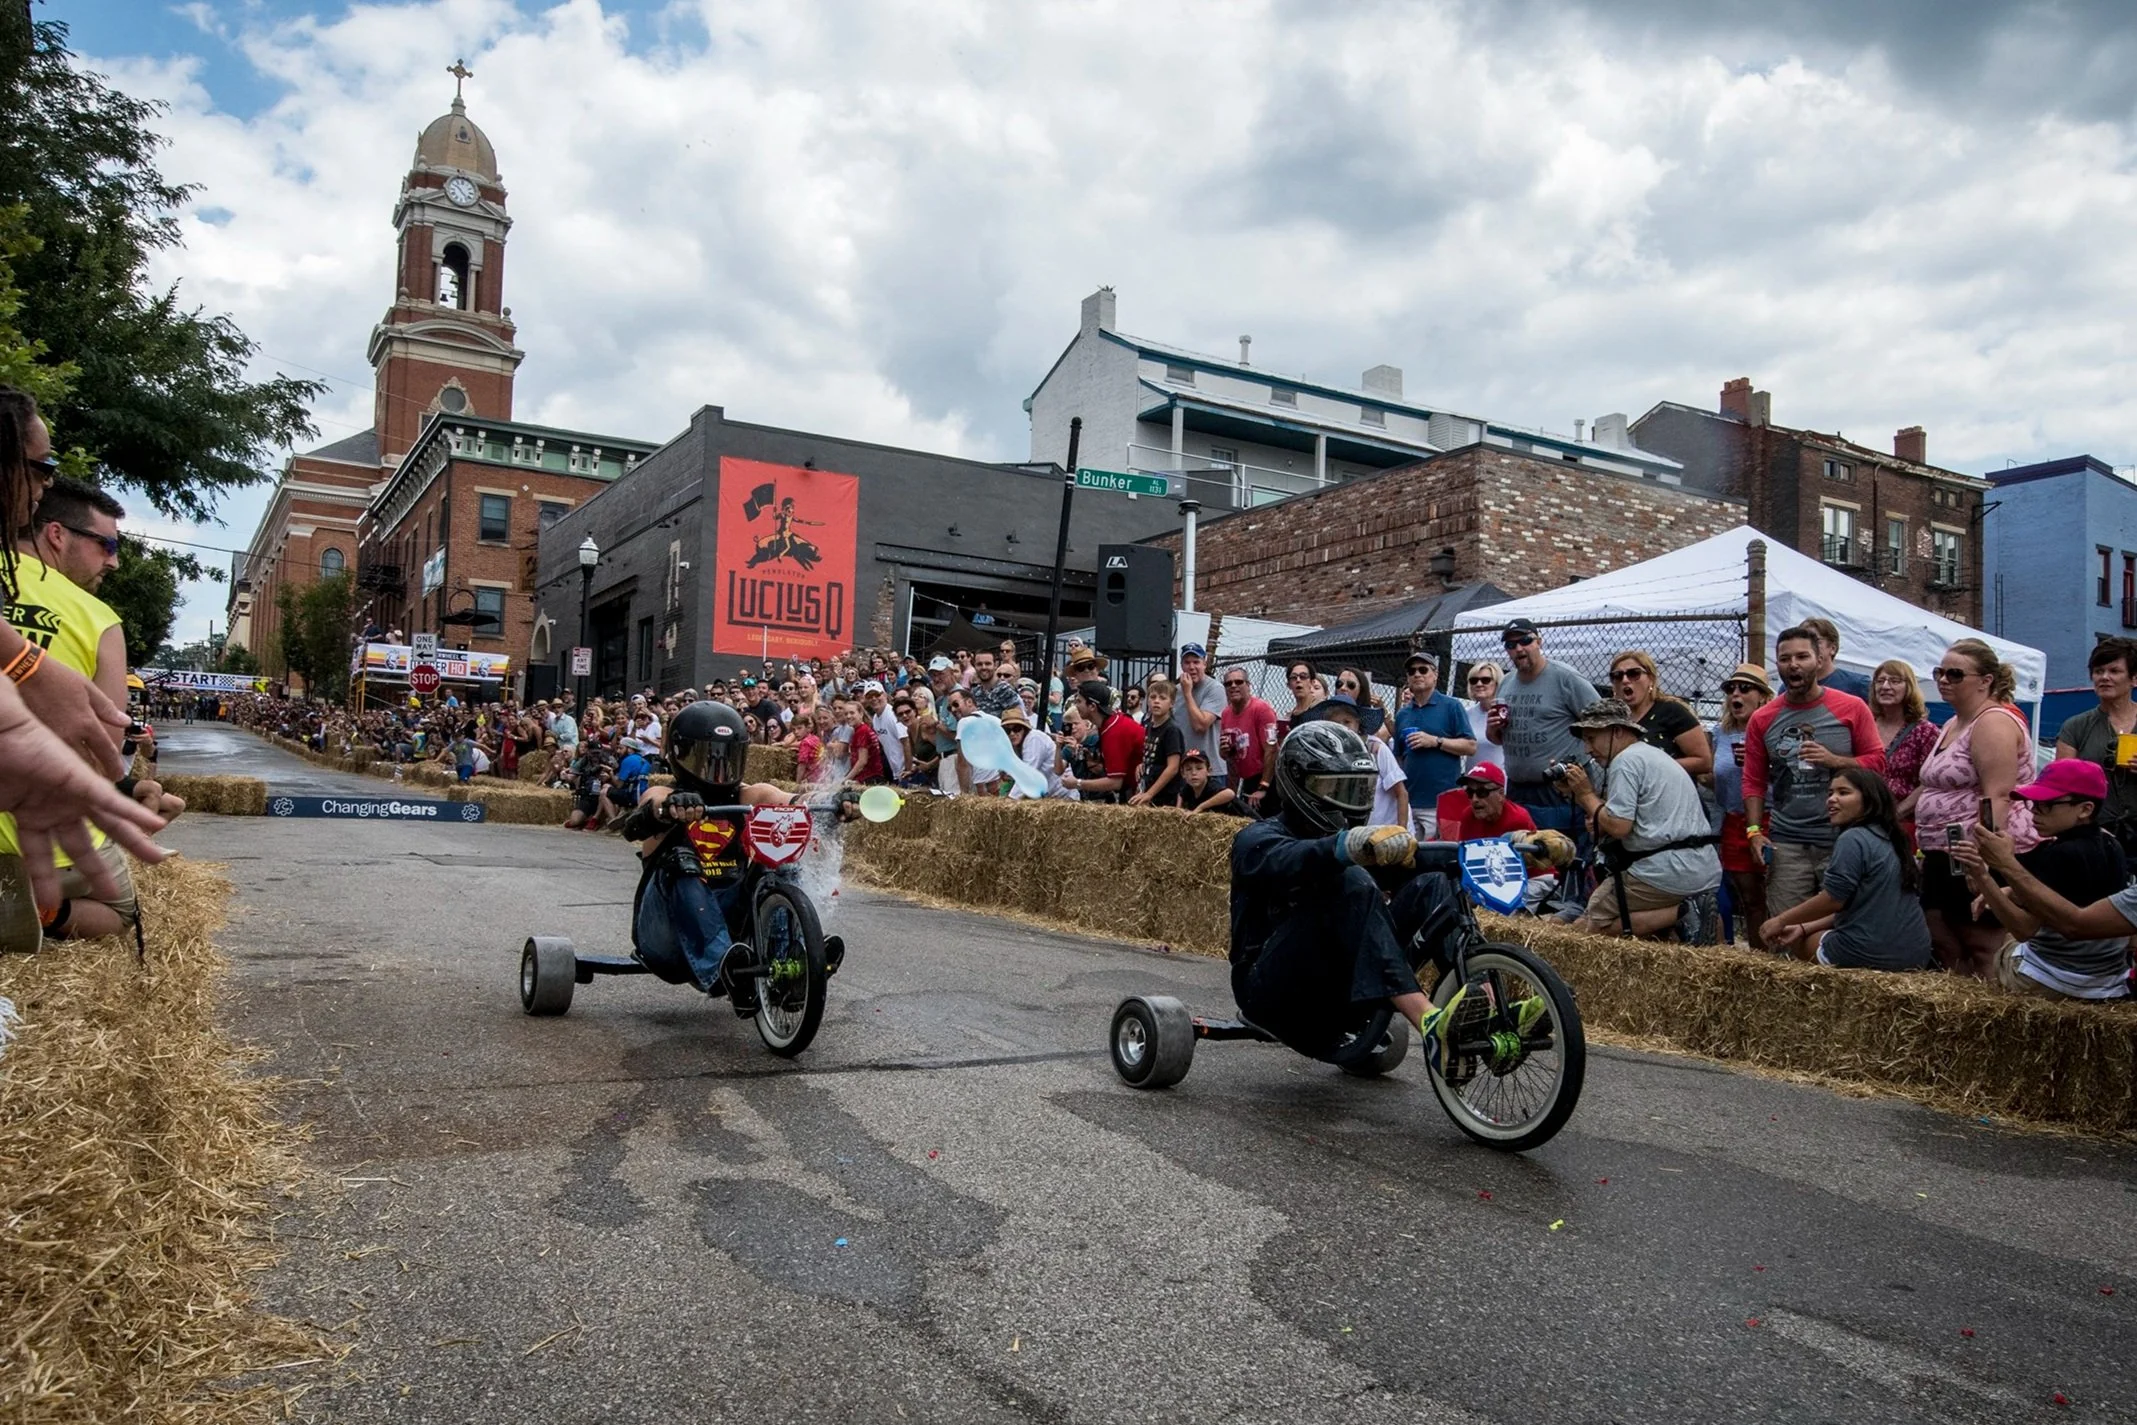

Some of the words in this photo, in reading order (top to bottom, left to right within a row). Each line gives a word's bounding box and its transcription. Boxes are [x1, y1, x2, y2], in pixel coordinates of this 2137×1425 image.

[1082, 470, 1133, 490] Bunker
[1149, 486, 1162, 494] 1131
[3, 605, 26, 622] ER
[825, 581, 843, 640] Q
[450, 662, 465, 675] HQ
[171, 672, 219, 685] START
[411, 673, 439, 685] STOP
[1520, 694, 1542, 704] YORK
[321, 799, 438, 817] ChangingGears
